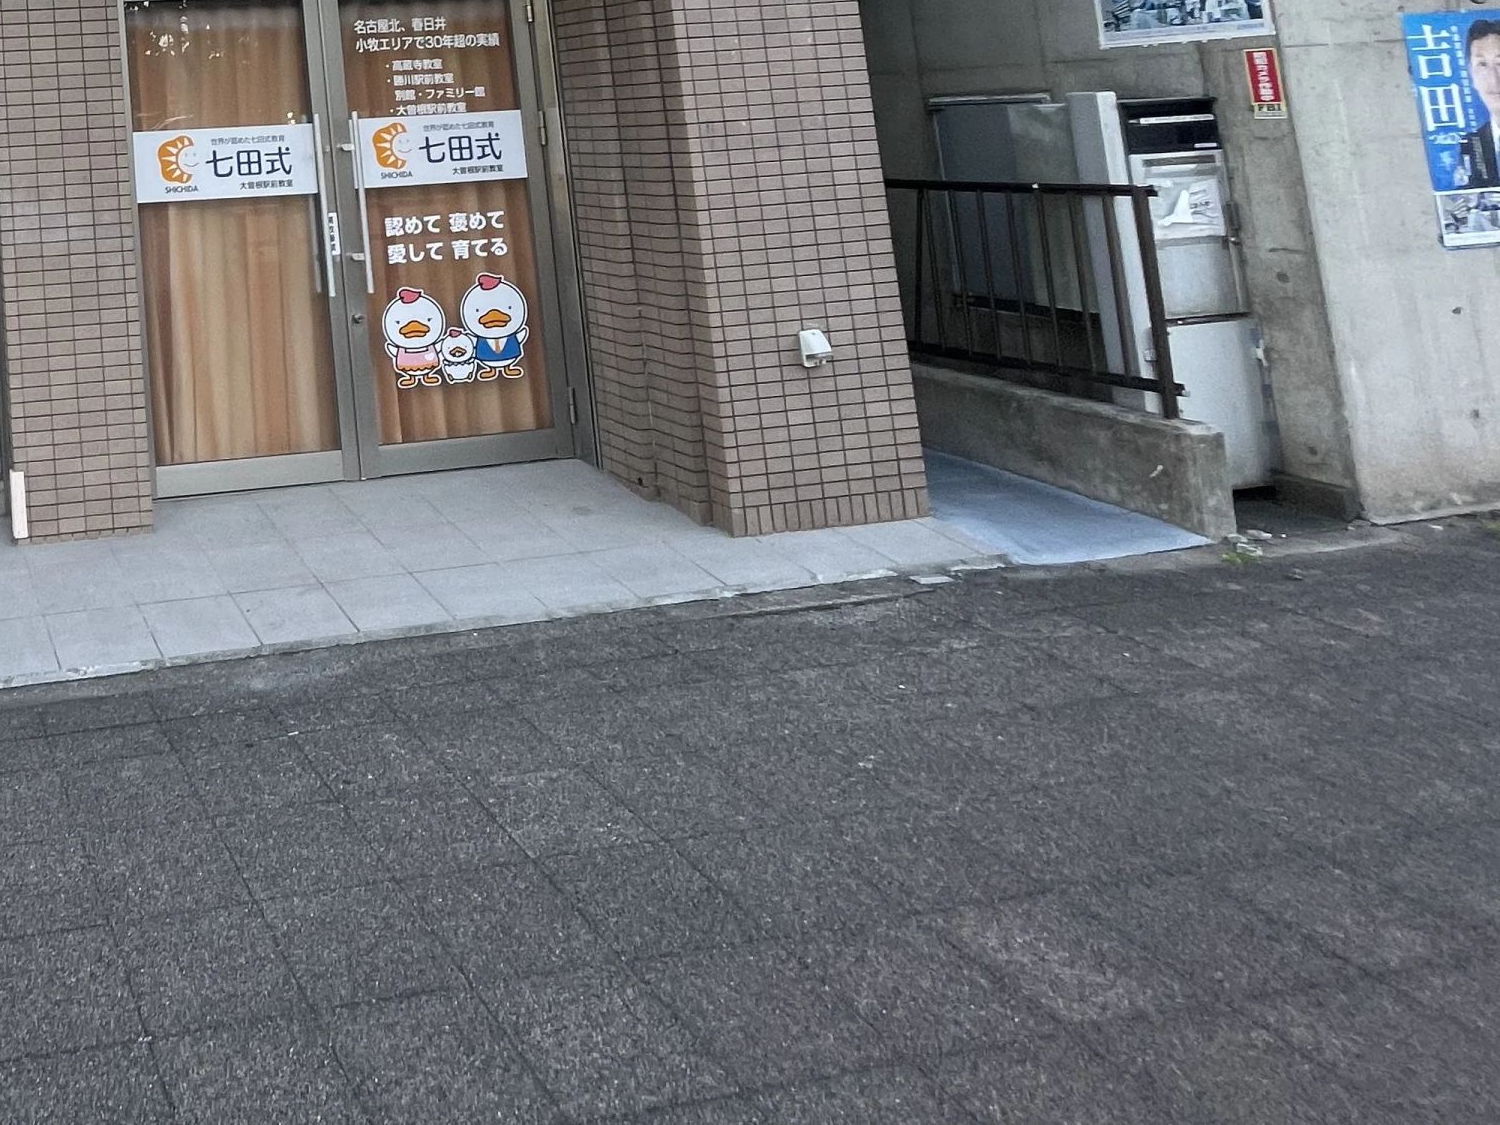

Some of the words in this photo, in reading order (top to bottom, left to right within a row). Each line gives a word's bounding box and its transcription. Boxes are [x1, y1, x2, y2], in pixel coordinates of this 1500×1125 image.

[1406, 24, 1466, 132] 吉田
[205, 146, 293, 178] 七田式
[418, 132, 502, 163] 七田式
[385, 215, 441, 237] 認めて
[387, 242, 443, 264] 愛して
[451, 237, 508, 260] 育てる
